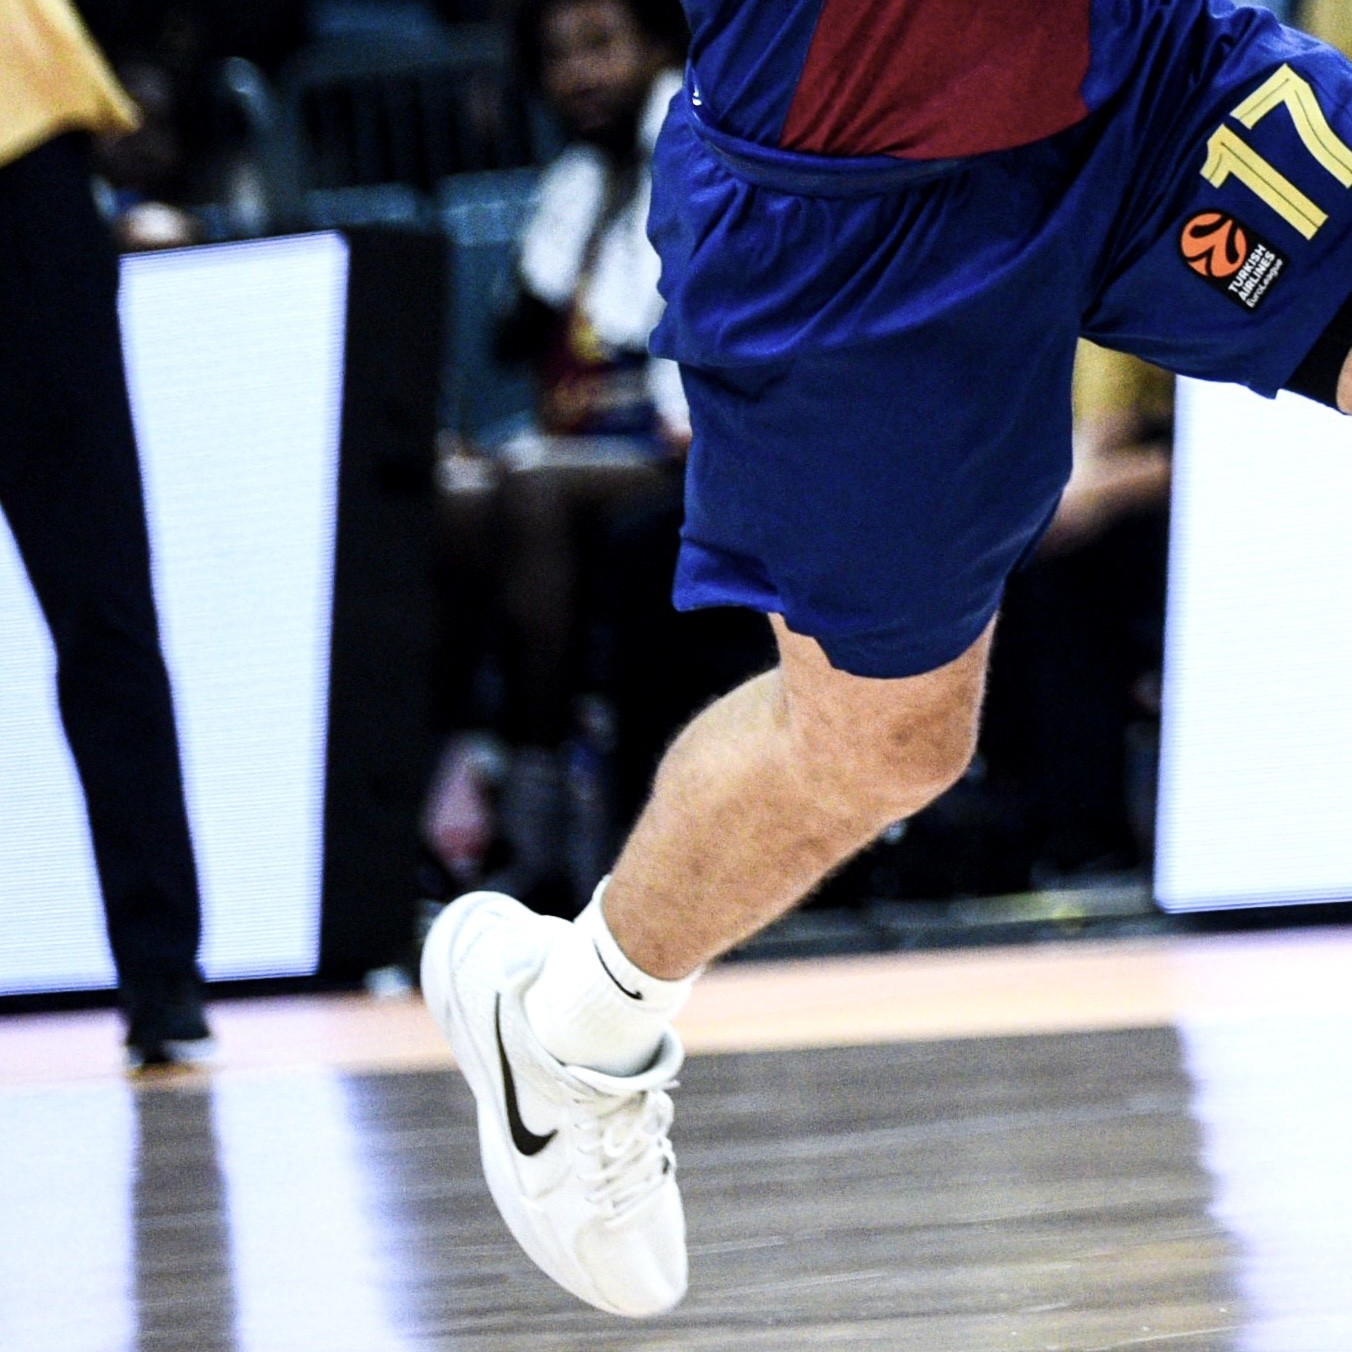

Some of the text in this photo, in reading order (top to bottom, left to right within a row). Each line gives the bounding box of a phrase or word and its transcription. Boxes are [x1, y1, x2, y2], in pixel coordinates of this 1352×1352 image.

[1228, 243, 1267, 293] TURKISH
[1238, 250, 1276, 302] AIRLINES
[1245, 258, 1284, 309] EuroLeague
